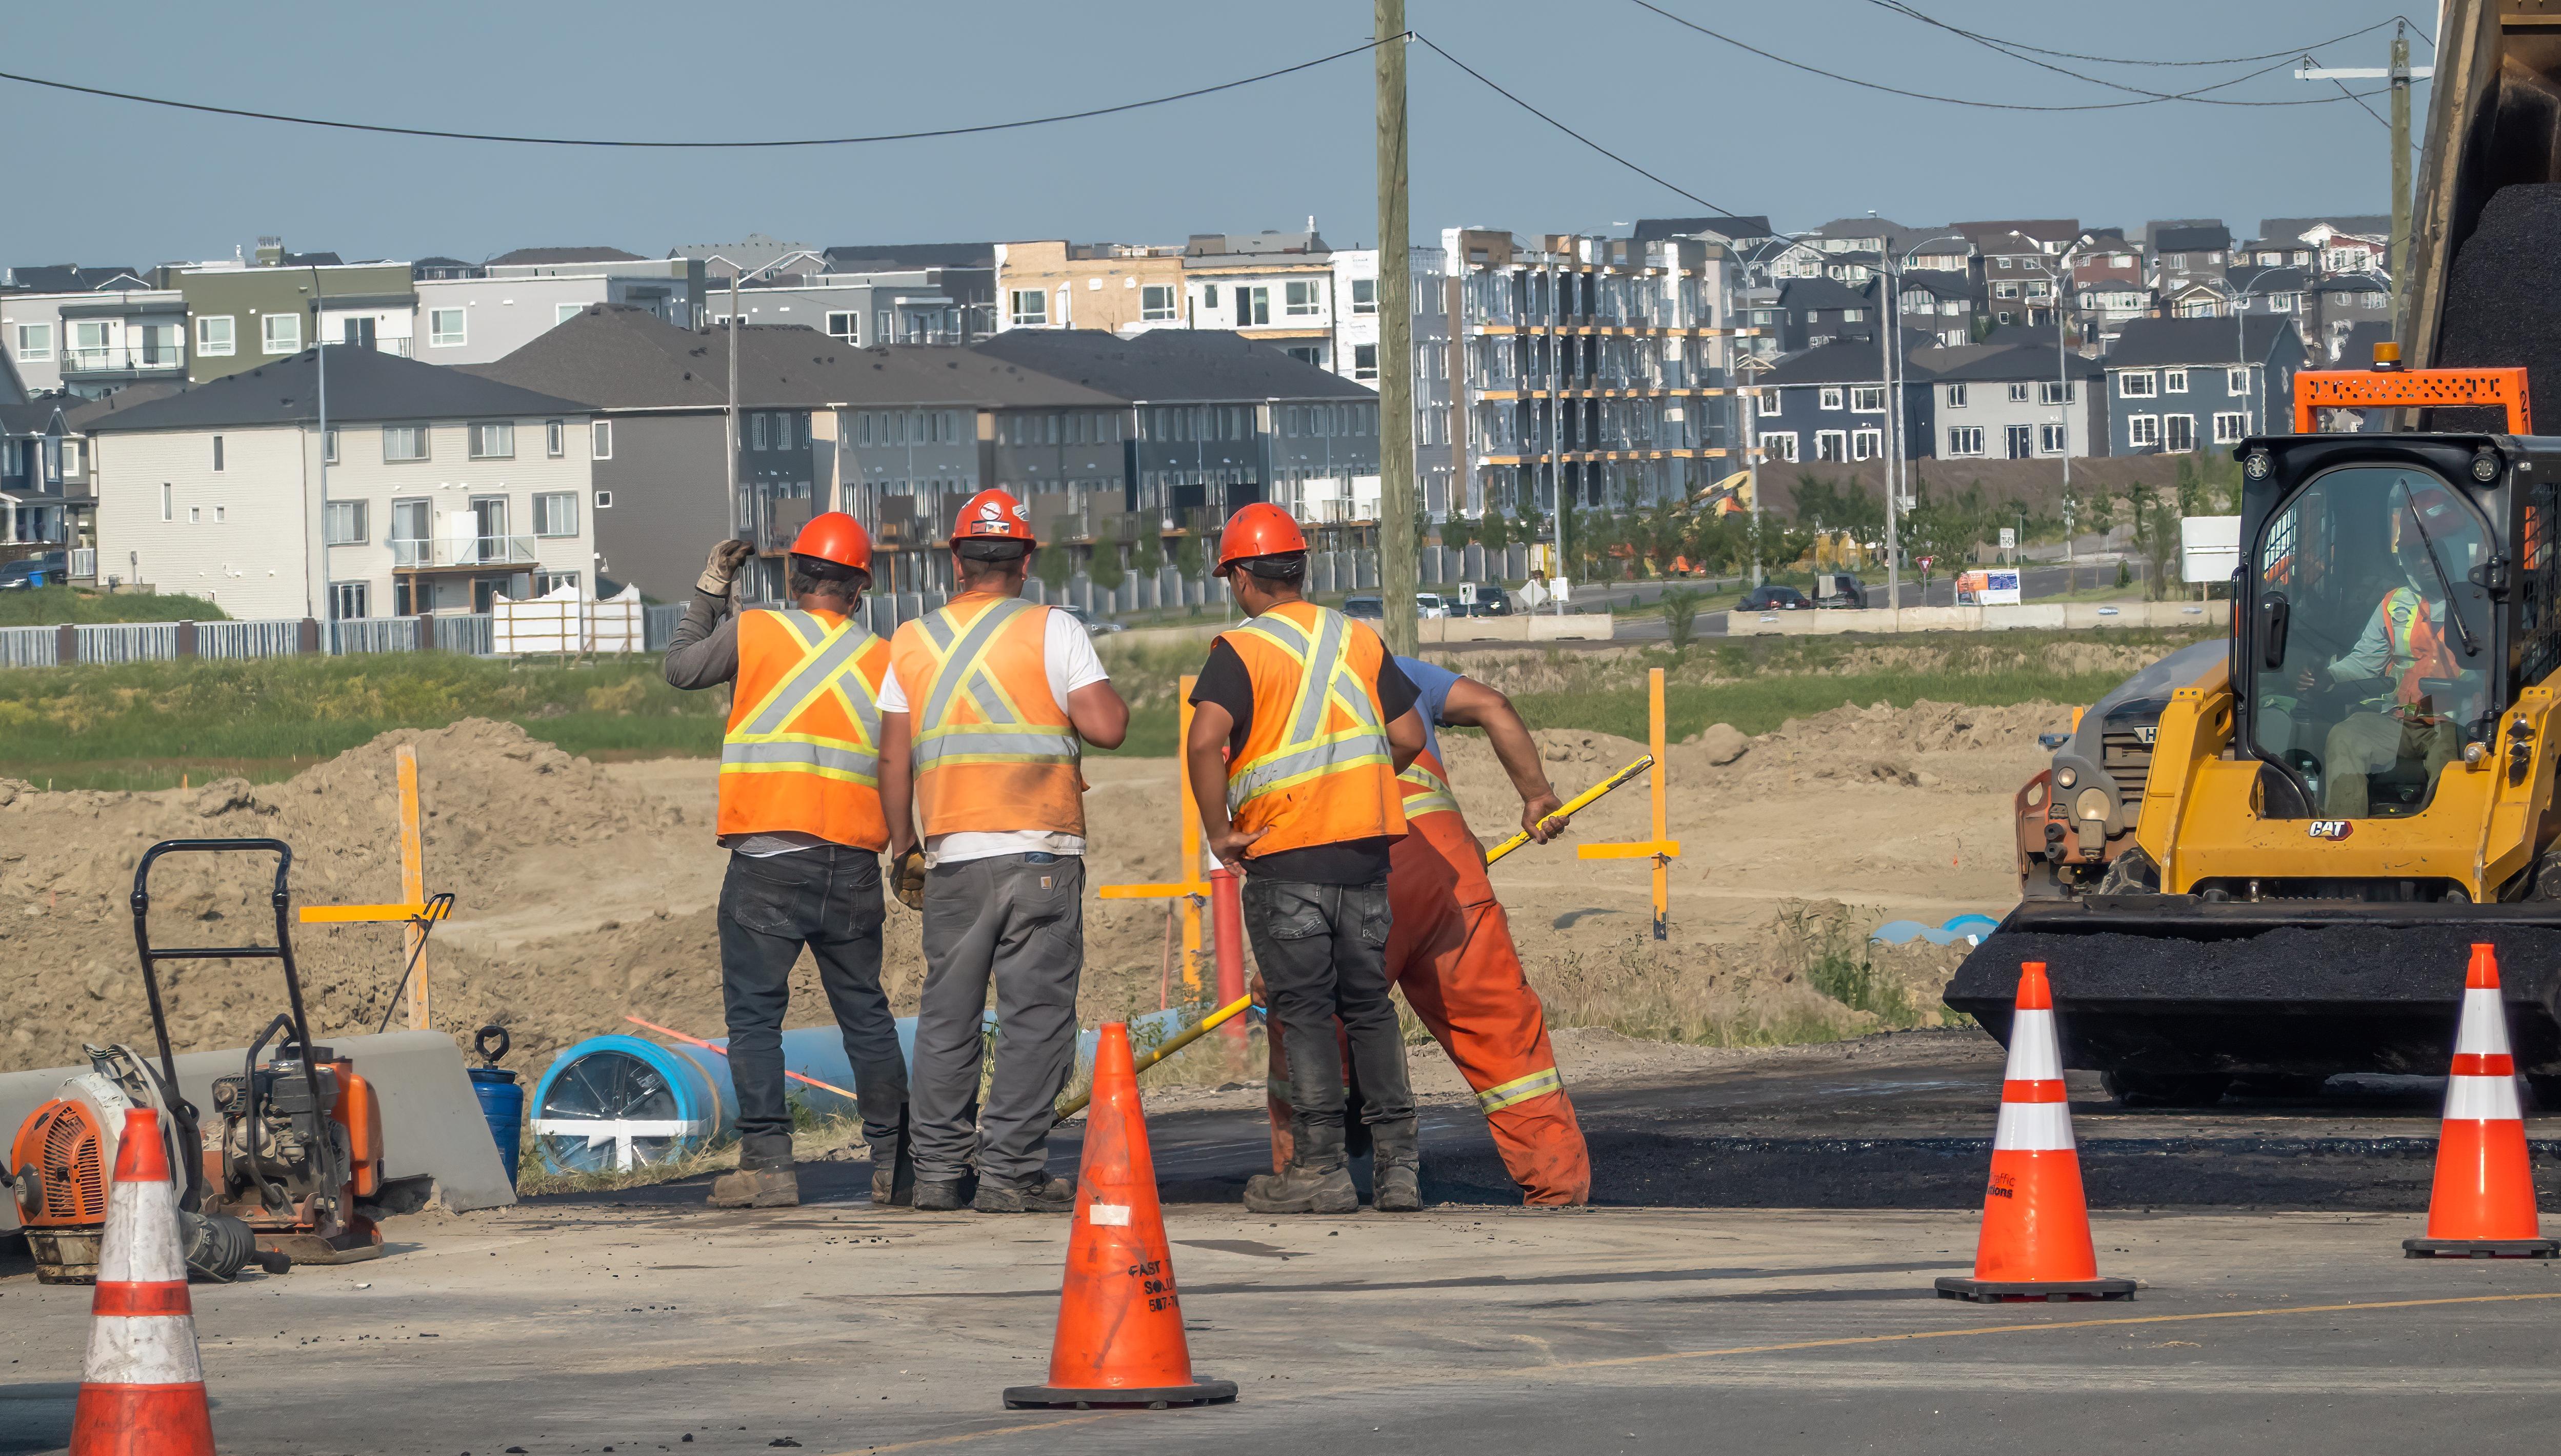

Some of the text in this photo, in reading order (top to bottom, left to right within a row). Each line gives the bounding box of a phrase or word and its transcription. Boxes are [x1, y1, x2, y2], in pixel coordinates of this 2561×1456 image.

[2146, 728, 2157, 742] H
[2310, 821, 2345, 837] CAT
[1128, 1261, 1161, 1278] FAST
